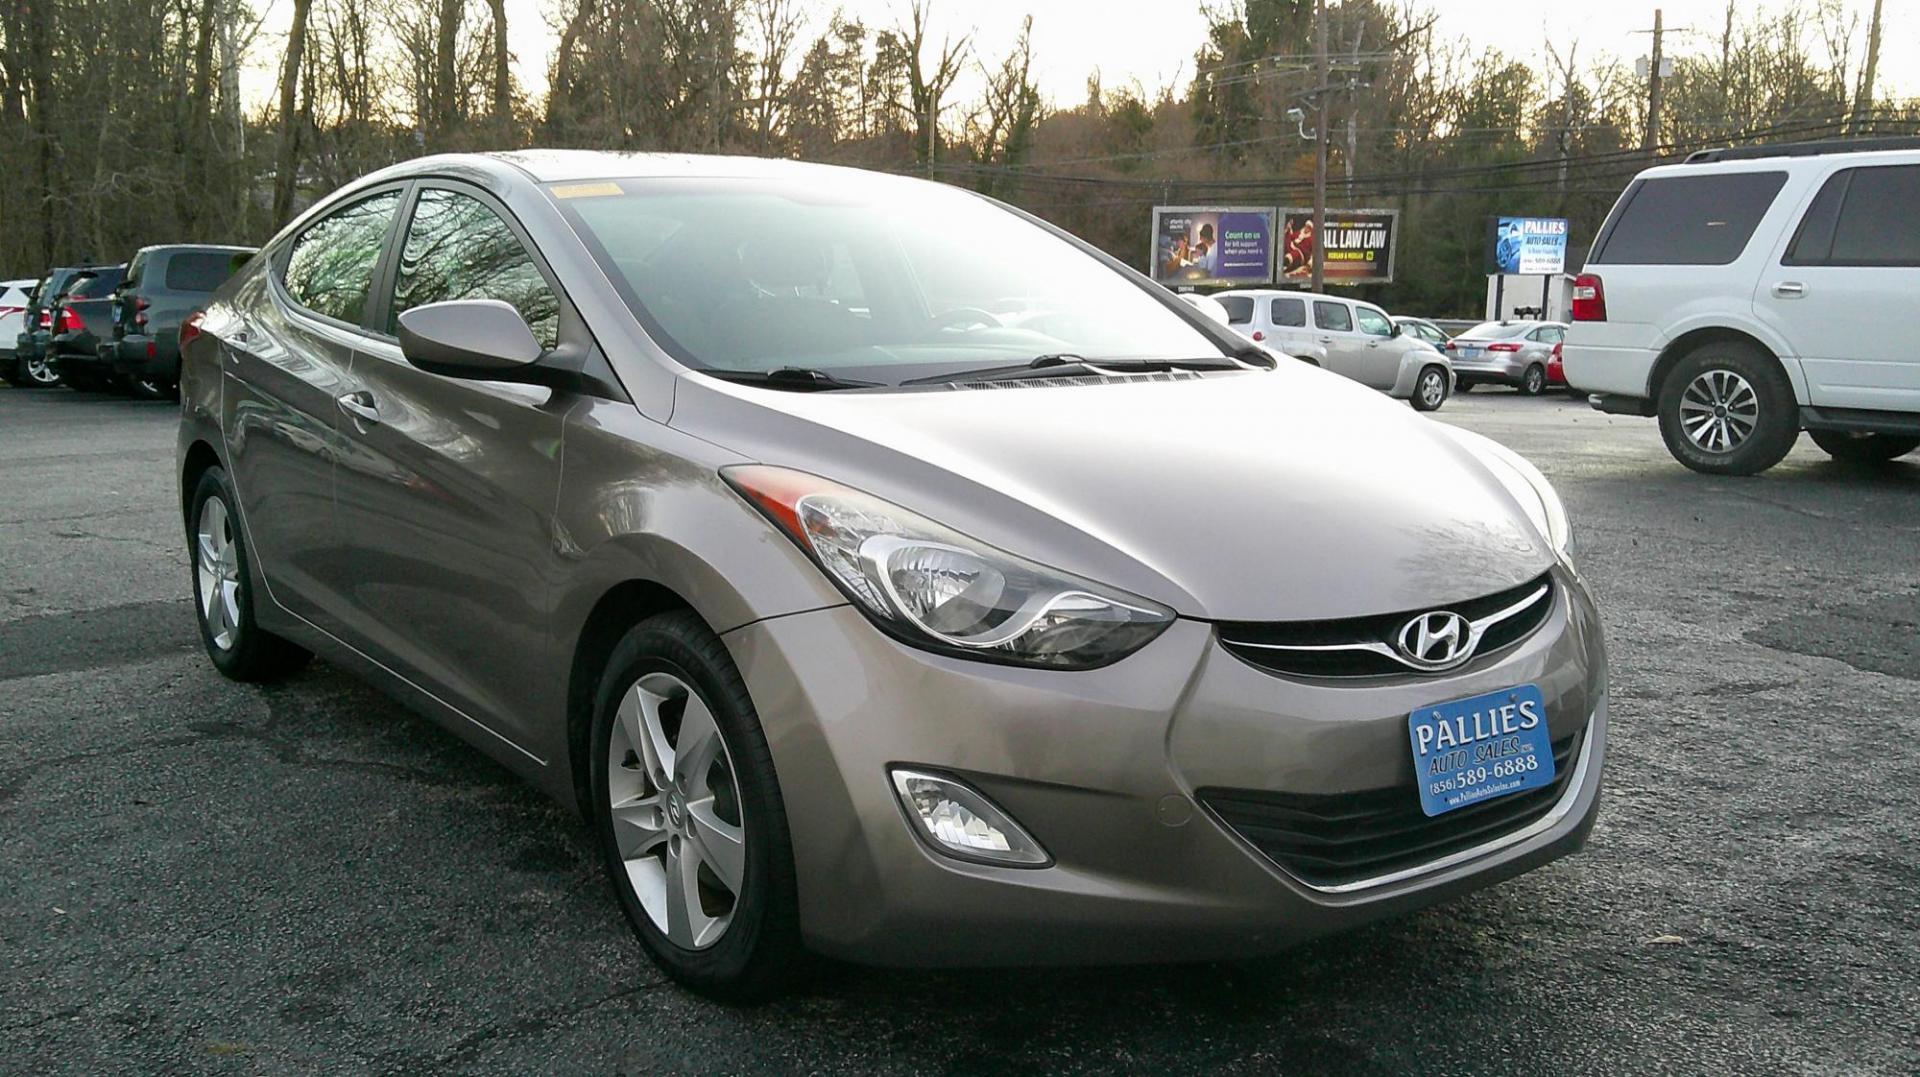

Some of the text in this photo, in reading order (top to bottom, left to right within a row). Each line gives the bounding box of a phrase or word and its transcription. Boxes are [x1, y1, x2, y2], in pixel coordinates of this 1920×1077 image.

[1225, 231, 1243, 239] Count
[1524, 220, 1565, 234] PALLIES
[1340, 229, 1363, 248] LAW
[1364, 230, 1386, 248] LAW
[1526, 236, 1541, 245] AUTO
[1541, 236, 1559, 246] SALES
[1415, 700, 1539, 755] PALLIES
[1428, 736, 1520, 777] AUTO SALES
[1430, 754, 1539, 796] (856) 589-6888
